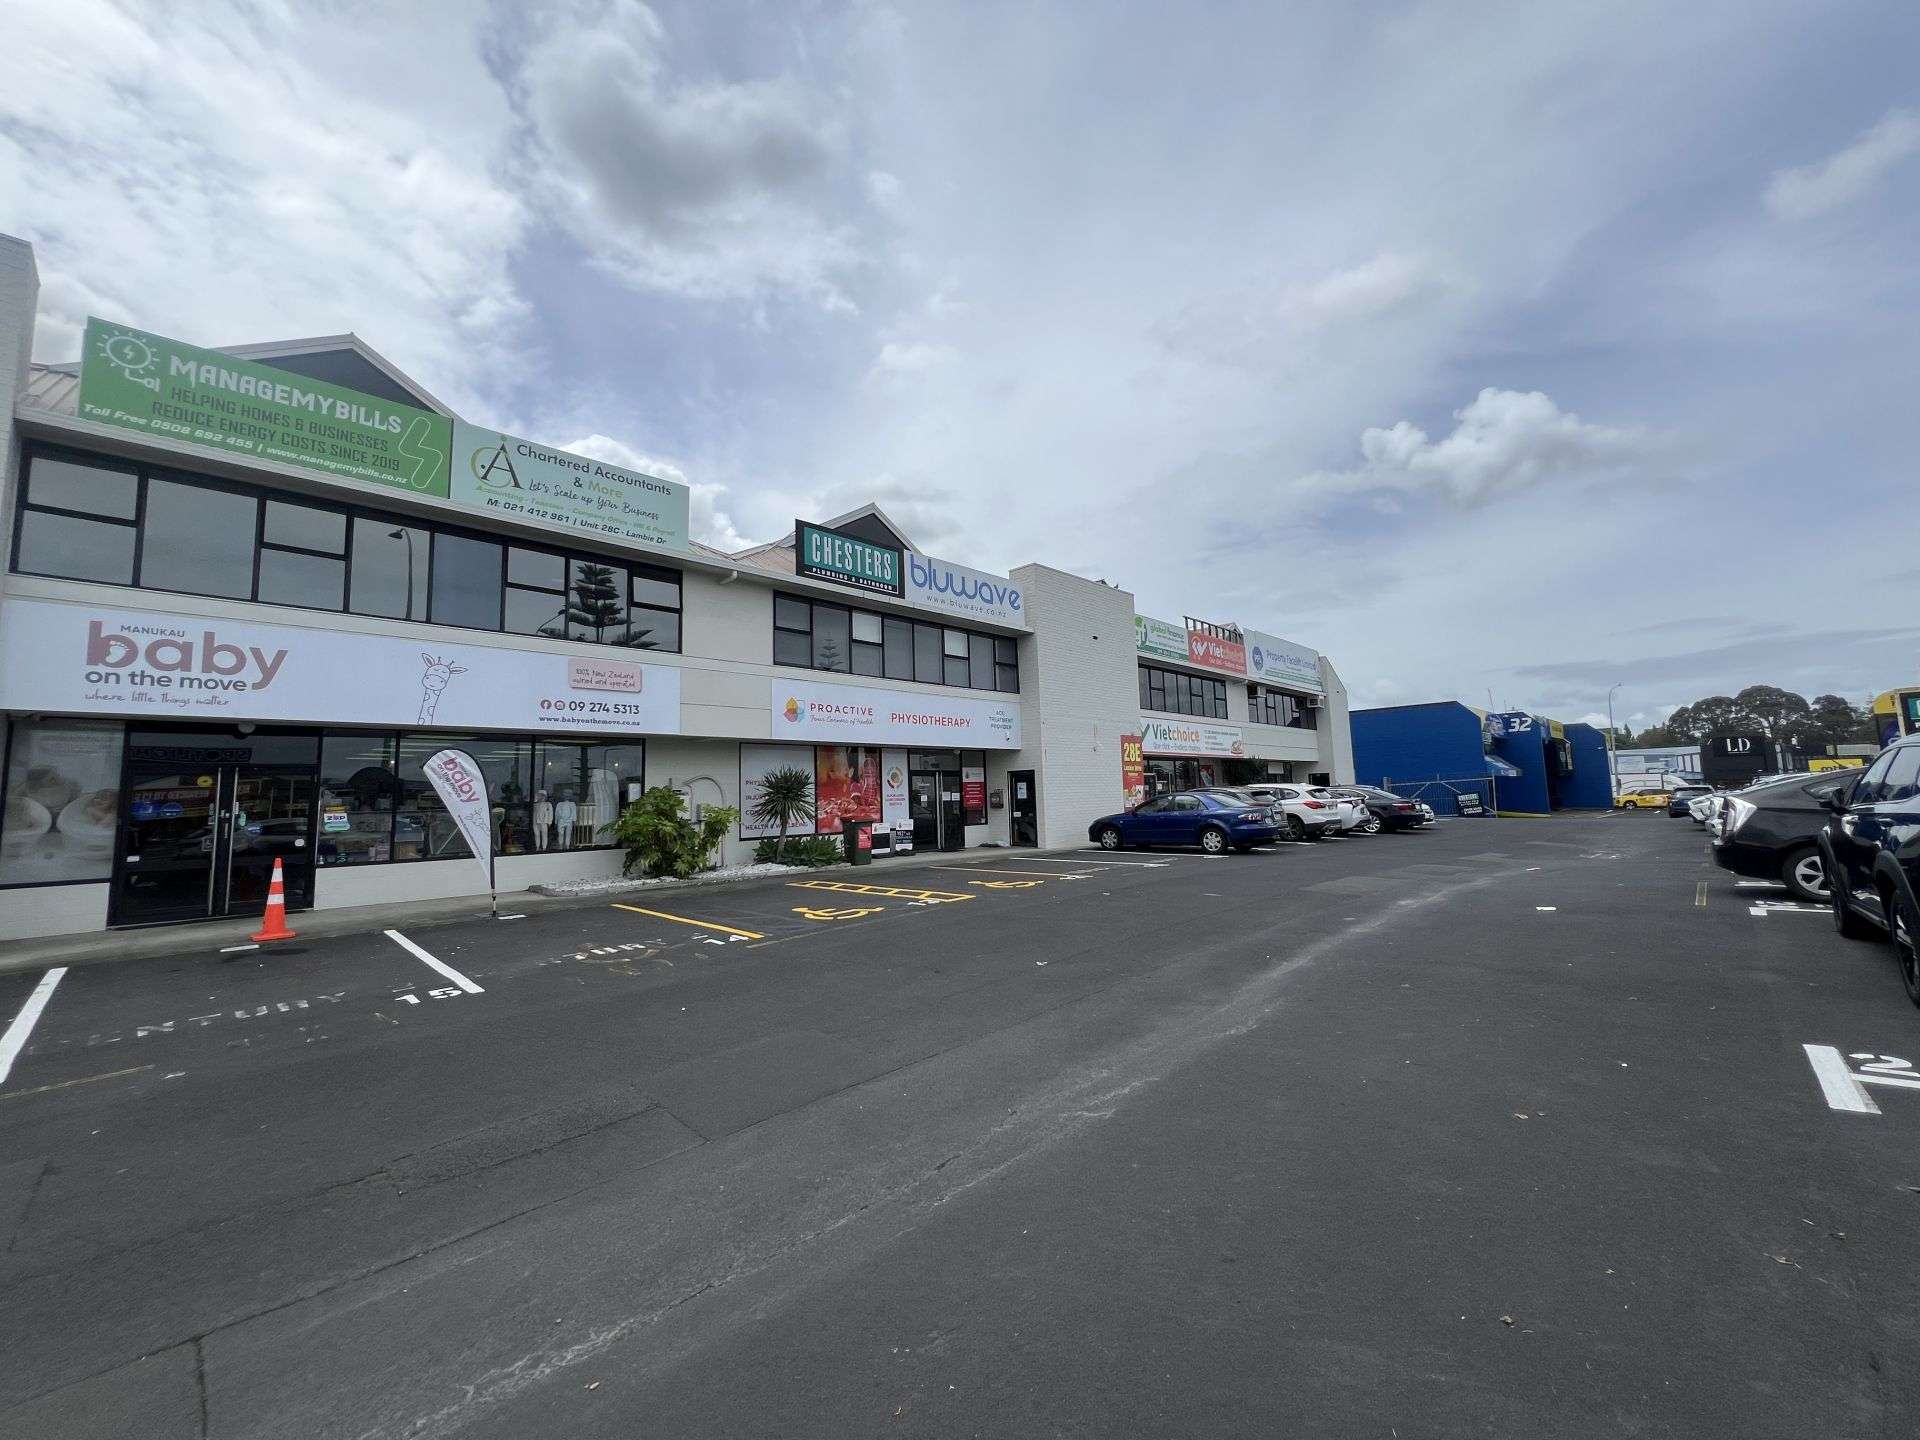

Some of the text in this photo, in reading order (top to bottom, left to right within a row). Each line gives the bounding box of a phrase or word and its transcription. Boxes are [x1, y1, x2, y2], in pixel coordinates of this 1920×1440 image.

[169, 355, 402, 434] MANAGEMYBILLS
[171, 387, 236, 414] HELPING
[241, 403, 290, 427] HOMES
[309, 421, 388, 452] BUSINESSES
[83, 403, 110, 416] Toll
[113, 411, 148, 425] Free
[150, 419, 191, 435] 0508
[193, 429, 223, 442] 692
[226, 436, 254, 449] 455
[266, 447, 409, 484] www.managemybills.co.nz
[152, 401, 400, 471] REDUCE ENERGY COSTS SINCE 2019
[516, 444, 672, 496] Chartered Accountants
[573, 476, 624, 498] & More
[503, 502, 524, 512] 021
[527, 507, 548, 518] 412
[550, 512, 570, 523] 961
[580, 519, 599, 530] Unit
[601, 524, 620, 534] 28C
[626, 530, 655, 542] Lambie
[811, 533, 892, 581] CHESTERS
[812, 567, 848, 580] PLUMBING
[859, 578, 893, 591] BATHROOM
[910, 553, 1021, 611] bluwave
[120, 625, 186, 638] MANUKAU
[86, 620, 289, 691] baby
[85, 669, 248, 692] on the move
[84, 688, 126, 702] where
[131, 689, 157, 703] little
[196, 695, 231, 706] matter
[568, 701, 640, 715] 09 274 5313
[810, 703, 873, 716] PROACTIVE
[891, 712, 971, 727] PHYSIOTHERAPY
[539, 716, 640, 727] www.babyonthemove.co.nz
[1508, 717, 1532, 732] 32
[1152, 723, 1200, 743] Vietchoice
[1123, 742, 1141, 762] 28E
[1727, 738, 1750, 751] LD
[441, 756, 480, 803] baby
[395, 987, 462, 1004] 15
